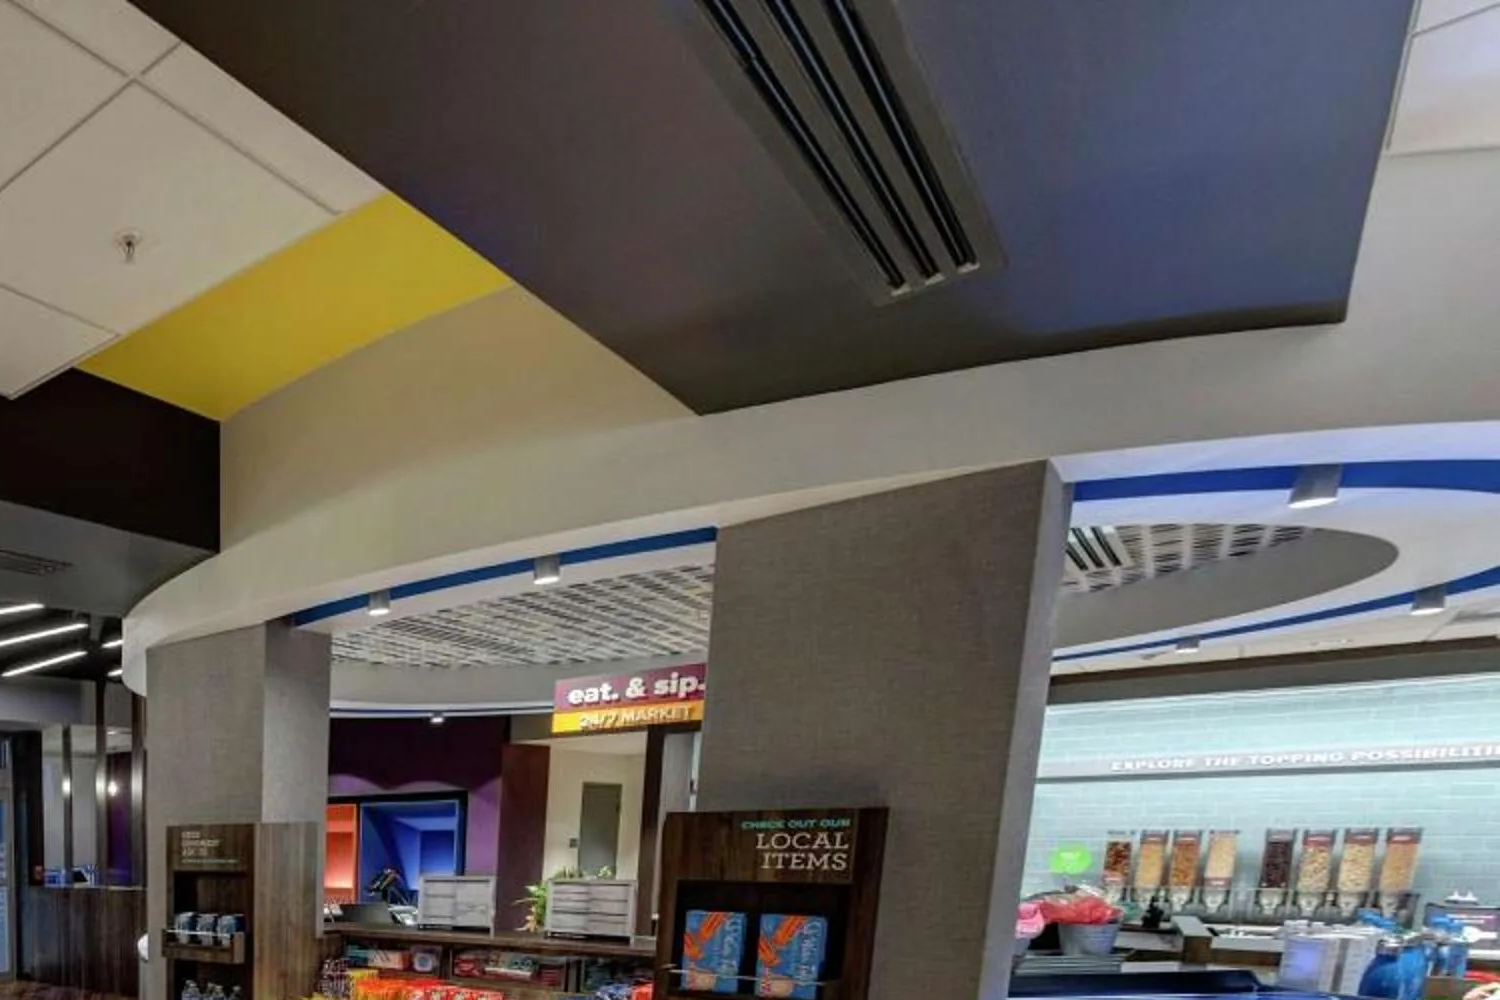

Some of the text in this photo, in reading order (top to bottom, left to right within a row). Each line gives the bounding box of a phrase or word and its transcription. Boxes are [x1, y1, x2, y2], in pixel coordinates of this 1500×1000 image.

[567, 682, 619, 704] eat.
[625, 676, 647, 699] &
[620, 705, 693, 722] MARKET
[1111, 757, 1196, 772] EXPLORE
[1204, 756, 1241, 767] THE
[1250, 751, 1344, 766] TOPPING
[787, 819, 817, 829] OUT
[755, 831, 849, 850] LOCAL
[761, 852, 848, 871] ITEMS
